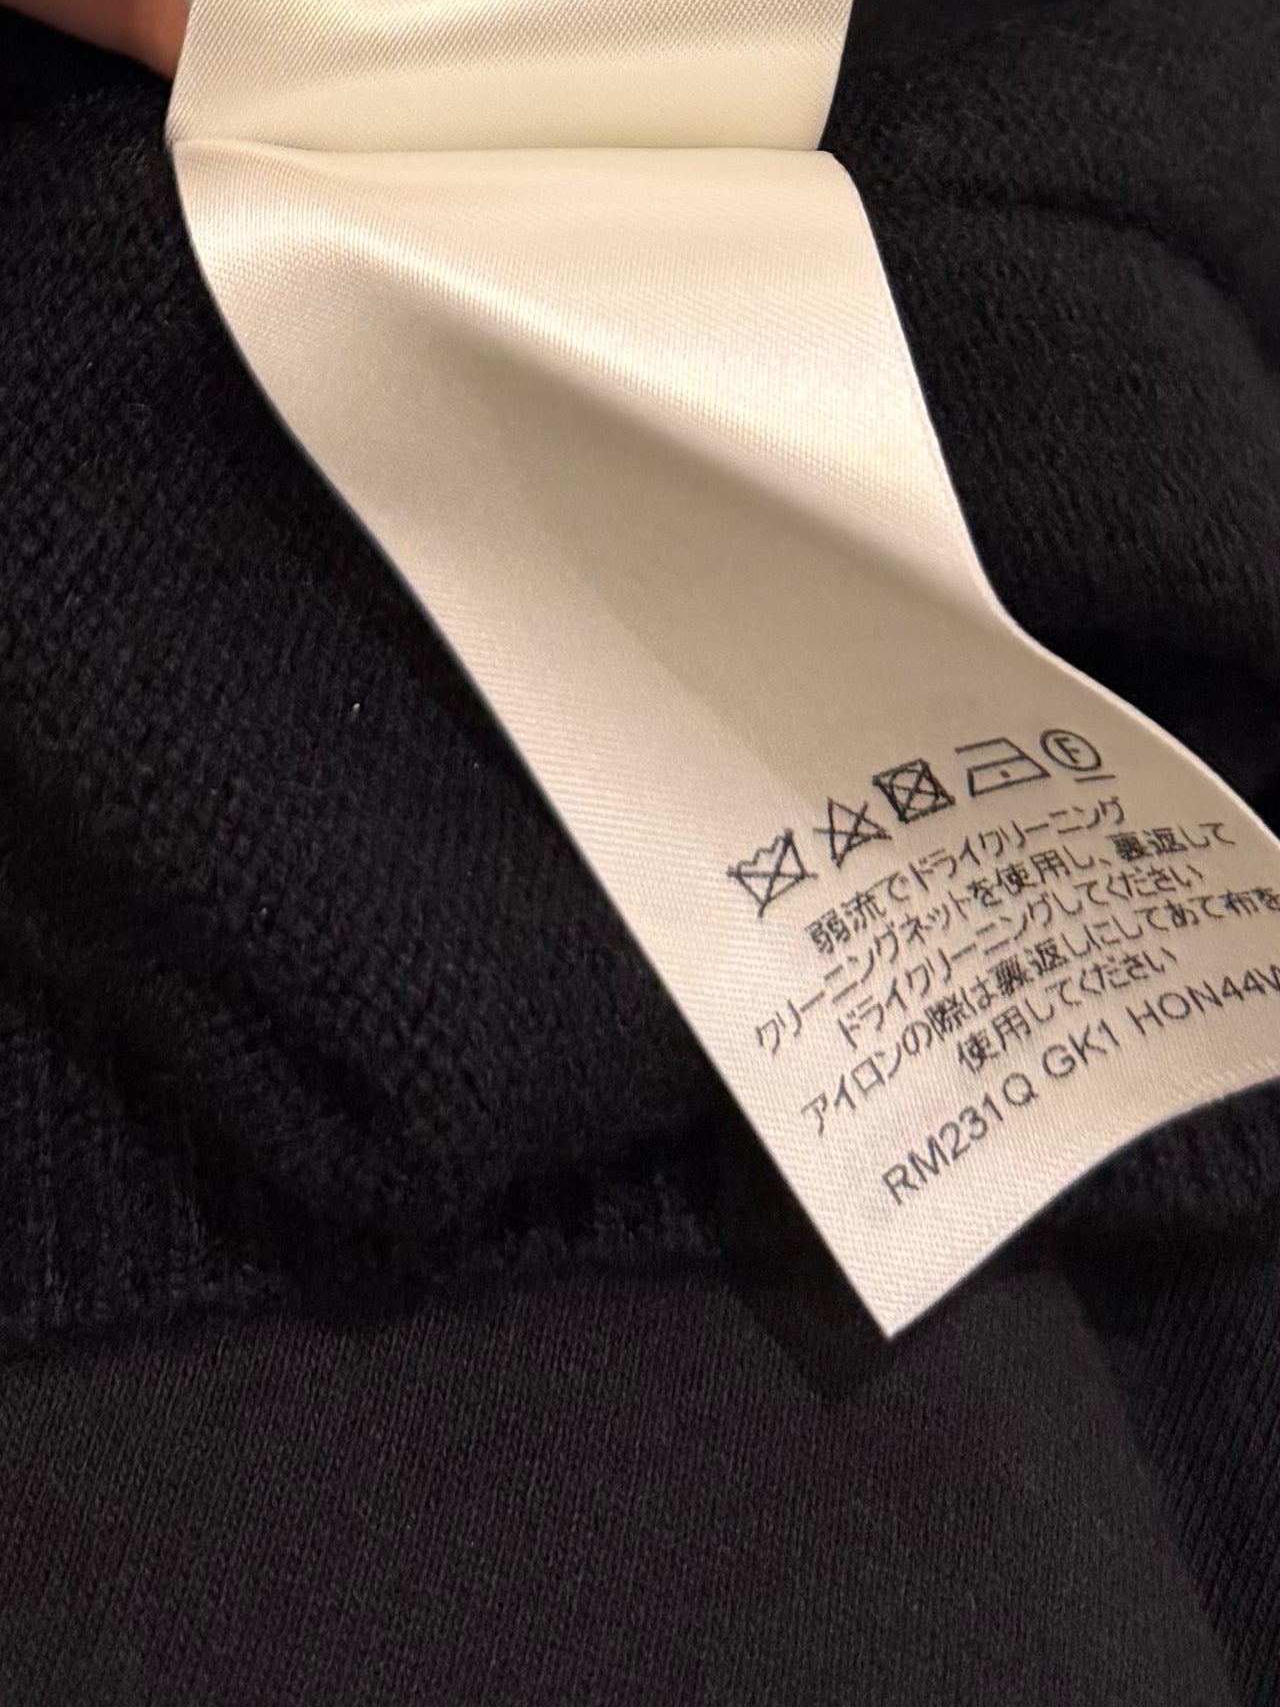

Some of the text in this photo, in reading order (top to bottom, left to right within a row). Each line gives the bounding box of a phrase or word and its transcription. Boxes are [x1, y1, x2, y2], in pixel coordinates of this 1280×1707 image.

[805, 796, 1125, 954] 弱流でドライクリーニング
[832, 864, 1203, 1050] ドライクリーニングしてください
[957, 947, 1177, 1075] 使用してください
[882, 1072, 1039, 1205] RM231Q
[1042, 1018, 1120, 1078] GK1
